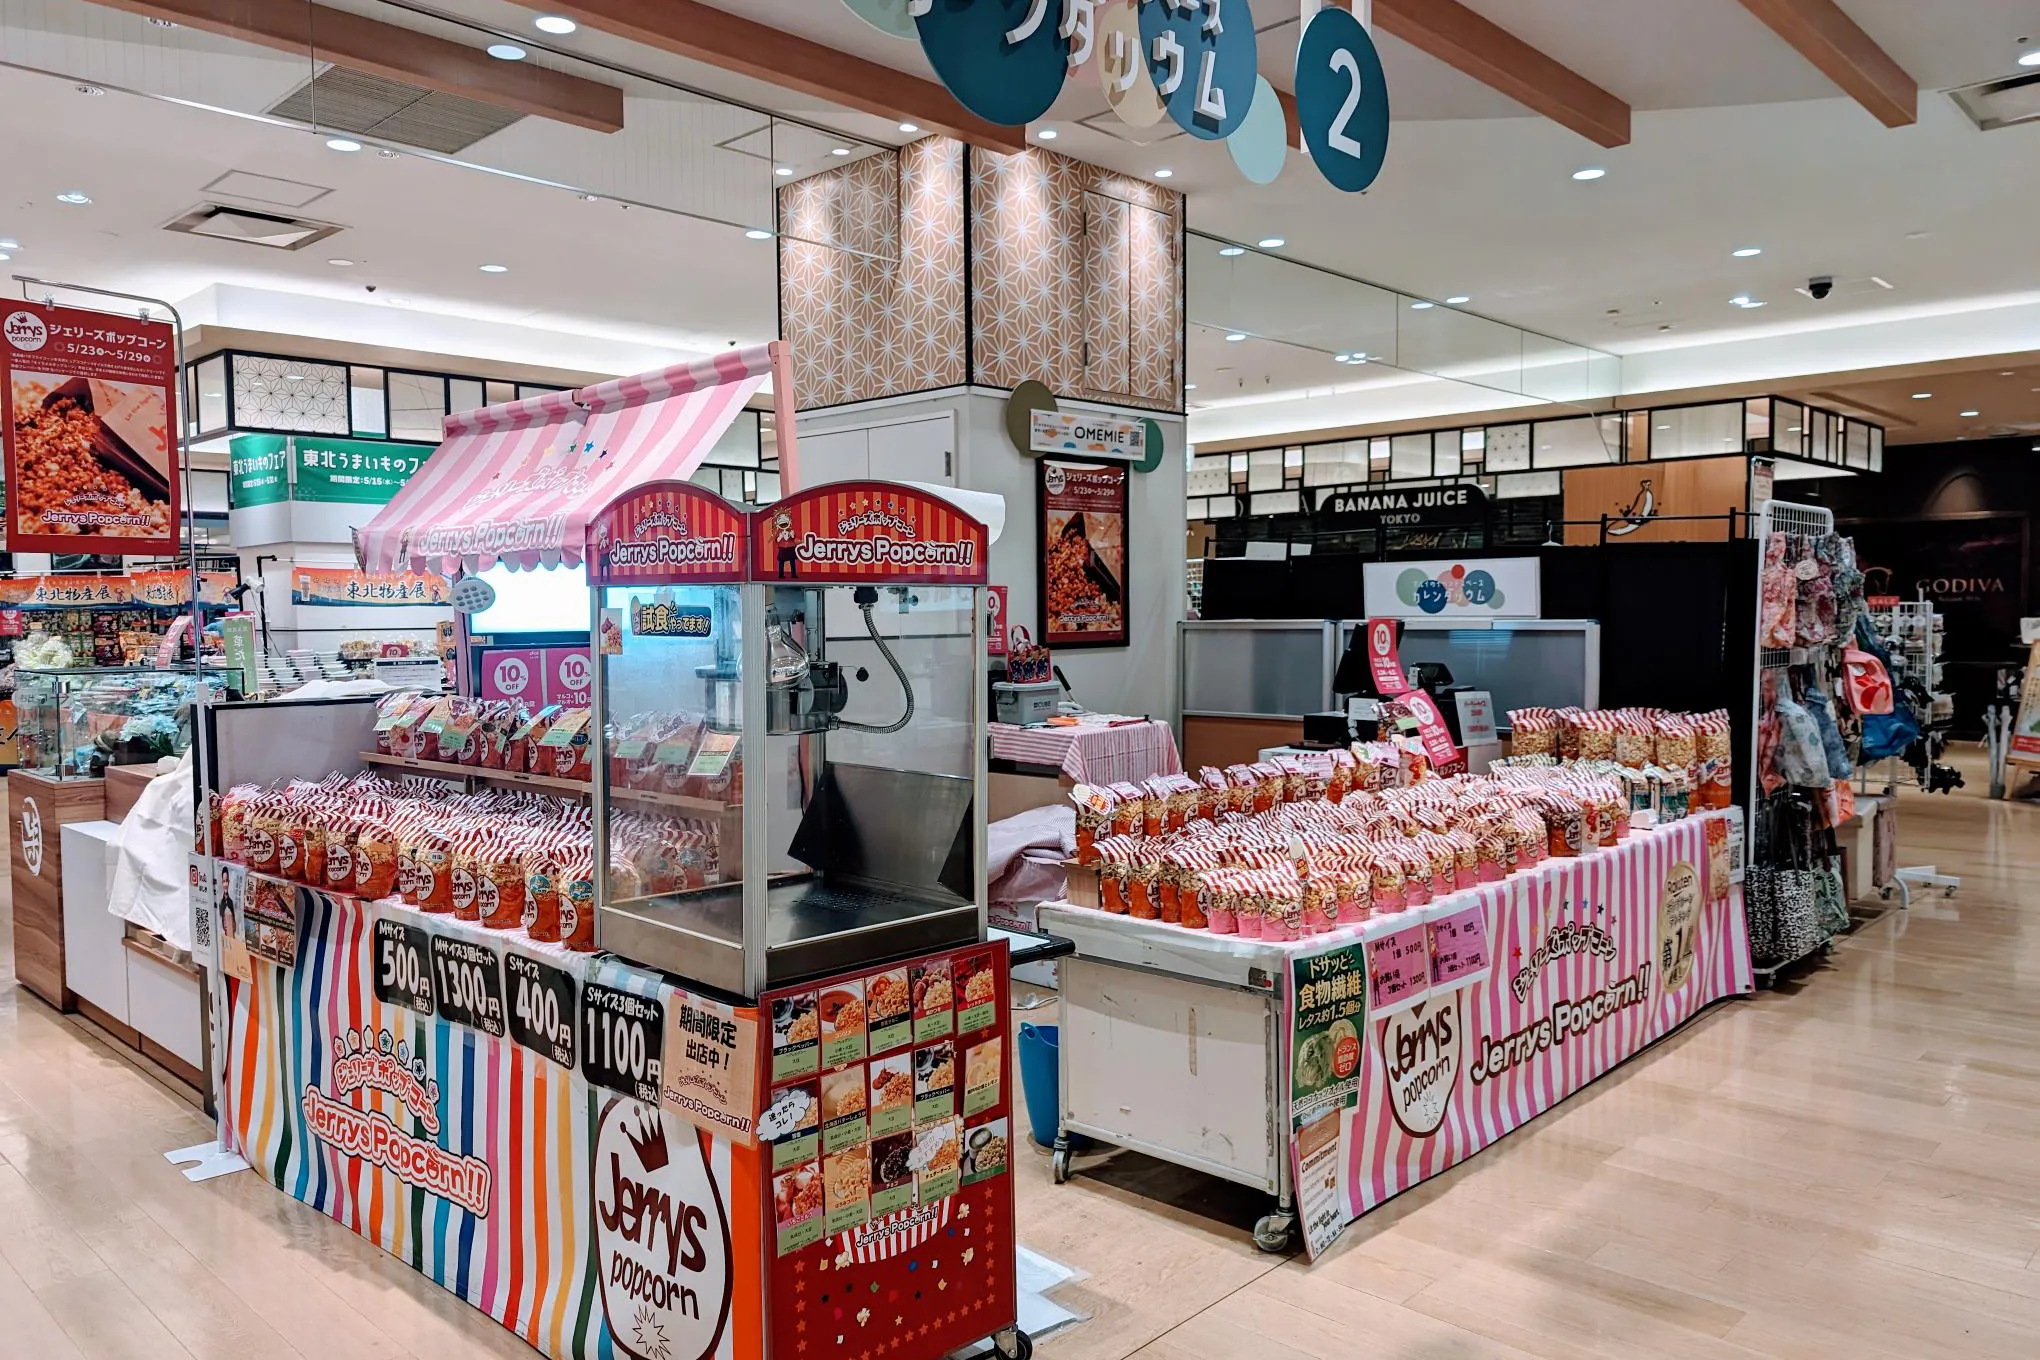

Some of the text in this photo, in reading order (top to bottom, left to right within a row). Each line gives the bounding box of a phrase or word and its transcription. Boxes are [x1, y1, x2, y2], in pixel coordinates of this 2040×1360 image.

[1328, 47, 1362, 160] 2
[11, 335, 42, 343] popcorn
[49, 323, 167, 350] ジェリーズポップコーン
[1074, 426, 1124, 444] OMEMIE
[232, 450, 287, 477] 東北うまいものフェア
[1334, 489, 1468, 513] BANANA JUICE
[42, 510, 151, 527] Jerrys Popcorn!!
[418, 512, 565, 556] Jerrys Popcorn!!
[838, 510, 917, 537] ジェリーズポップコーン
[1380, 512, 1421, 525] TOKYO
[610, 532, 736, 566] Jerrys Popcorn!!
[797, 532, 973, 567] Jerrys Popcorn!!
[35, 584, 112, 602] 東北物産展
[346, 581, 427, 600] 東北物産展
[1916, 577, 2005, 594] GODIVA
[1376, 630, 1387, 645] 10
[505, 683, 520, 691] OFF
[379, 920, 405, 942] Mサイズ
[434, 937, 496, 966] Mサイズ3個セット
[509, 956, 540, 980] Sサイズ
[1309, 953, 1349, 979] ドサッと
[1512, 920, 1617, 1003] ジェリーズポップコーン
[382, 939, 430, 998] 500円
[437, 955, 500, 1019] 1300円
[1298, 969, 1362, 1012] 食物繊維
[515, 975, 572, 1049] 400円
[587, 986, 659, 1022] Sサイズ3個セット
[1298, 999, 1361, 1030] レタス約1.5個分
[679, 1003, 737, 1050] 期間限定
[1470, 961, 1651, 1086] Jerrys Popcorn!!
[587, 1007, 662, 1086] 1100円
[685, 1038, 730, 1071] 出店中!
[778, 1041, 815, 1054] ブラックペッパー
[1391, 1005, 1452, 1083] Jerrys
[335, 1054, 439, 1131] ジェリーズポップコーン
[1402, 1055, 1450, 1113] popcorn
[664, 1085, 752, 1133] Jerrys Popcorn!!
[304, 1092, 486, 1206] Jerrys Popcorn!!
[1301, 1141, 1338, 1174] Commitment
[598, 1151, 708, 1278] Jerrys
[856, 1226, 890, 1247] Jerrys
[890, 1206, 939, 1235] Popcorn!!
[609, 1249, 700, 1321] popcorn
